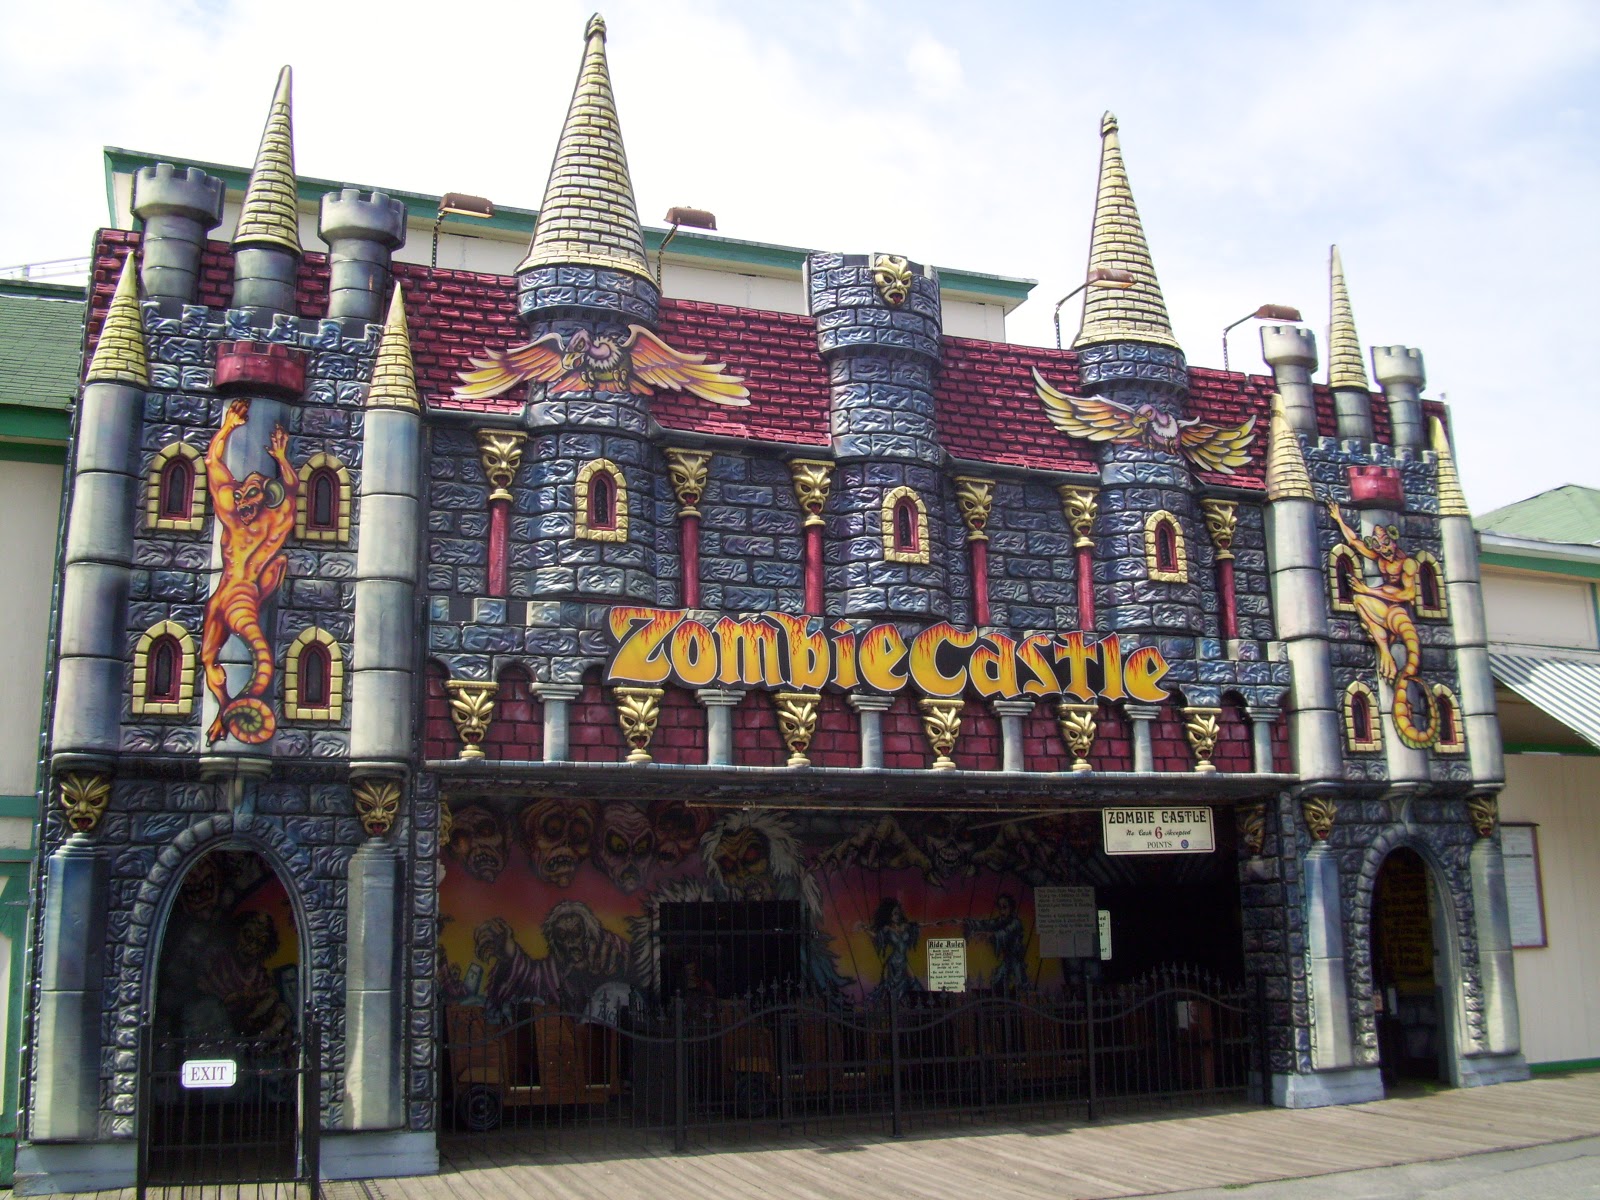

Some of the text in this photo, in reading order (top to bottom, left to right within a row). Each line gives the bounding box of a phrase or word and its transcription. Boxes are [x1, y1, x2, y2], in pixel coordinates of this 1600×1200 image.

[1108, 810, 1207, 824] ZOMBIE CASTLE
[1154, 826, 1163, 839] 6
[1164, 828, 1192, 837] Accepted
[1147, 841, 1173, 849] POINTS
[191, 1066, 227, 1081] EXIT
